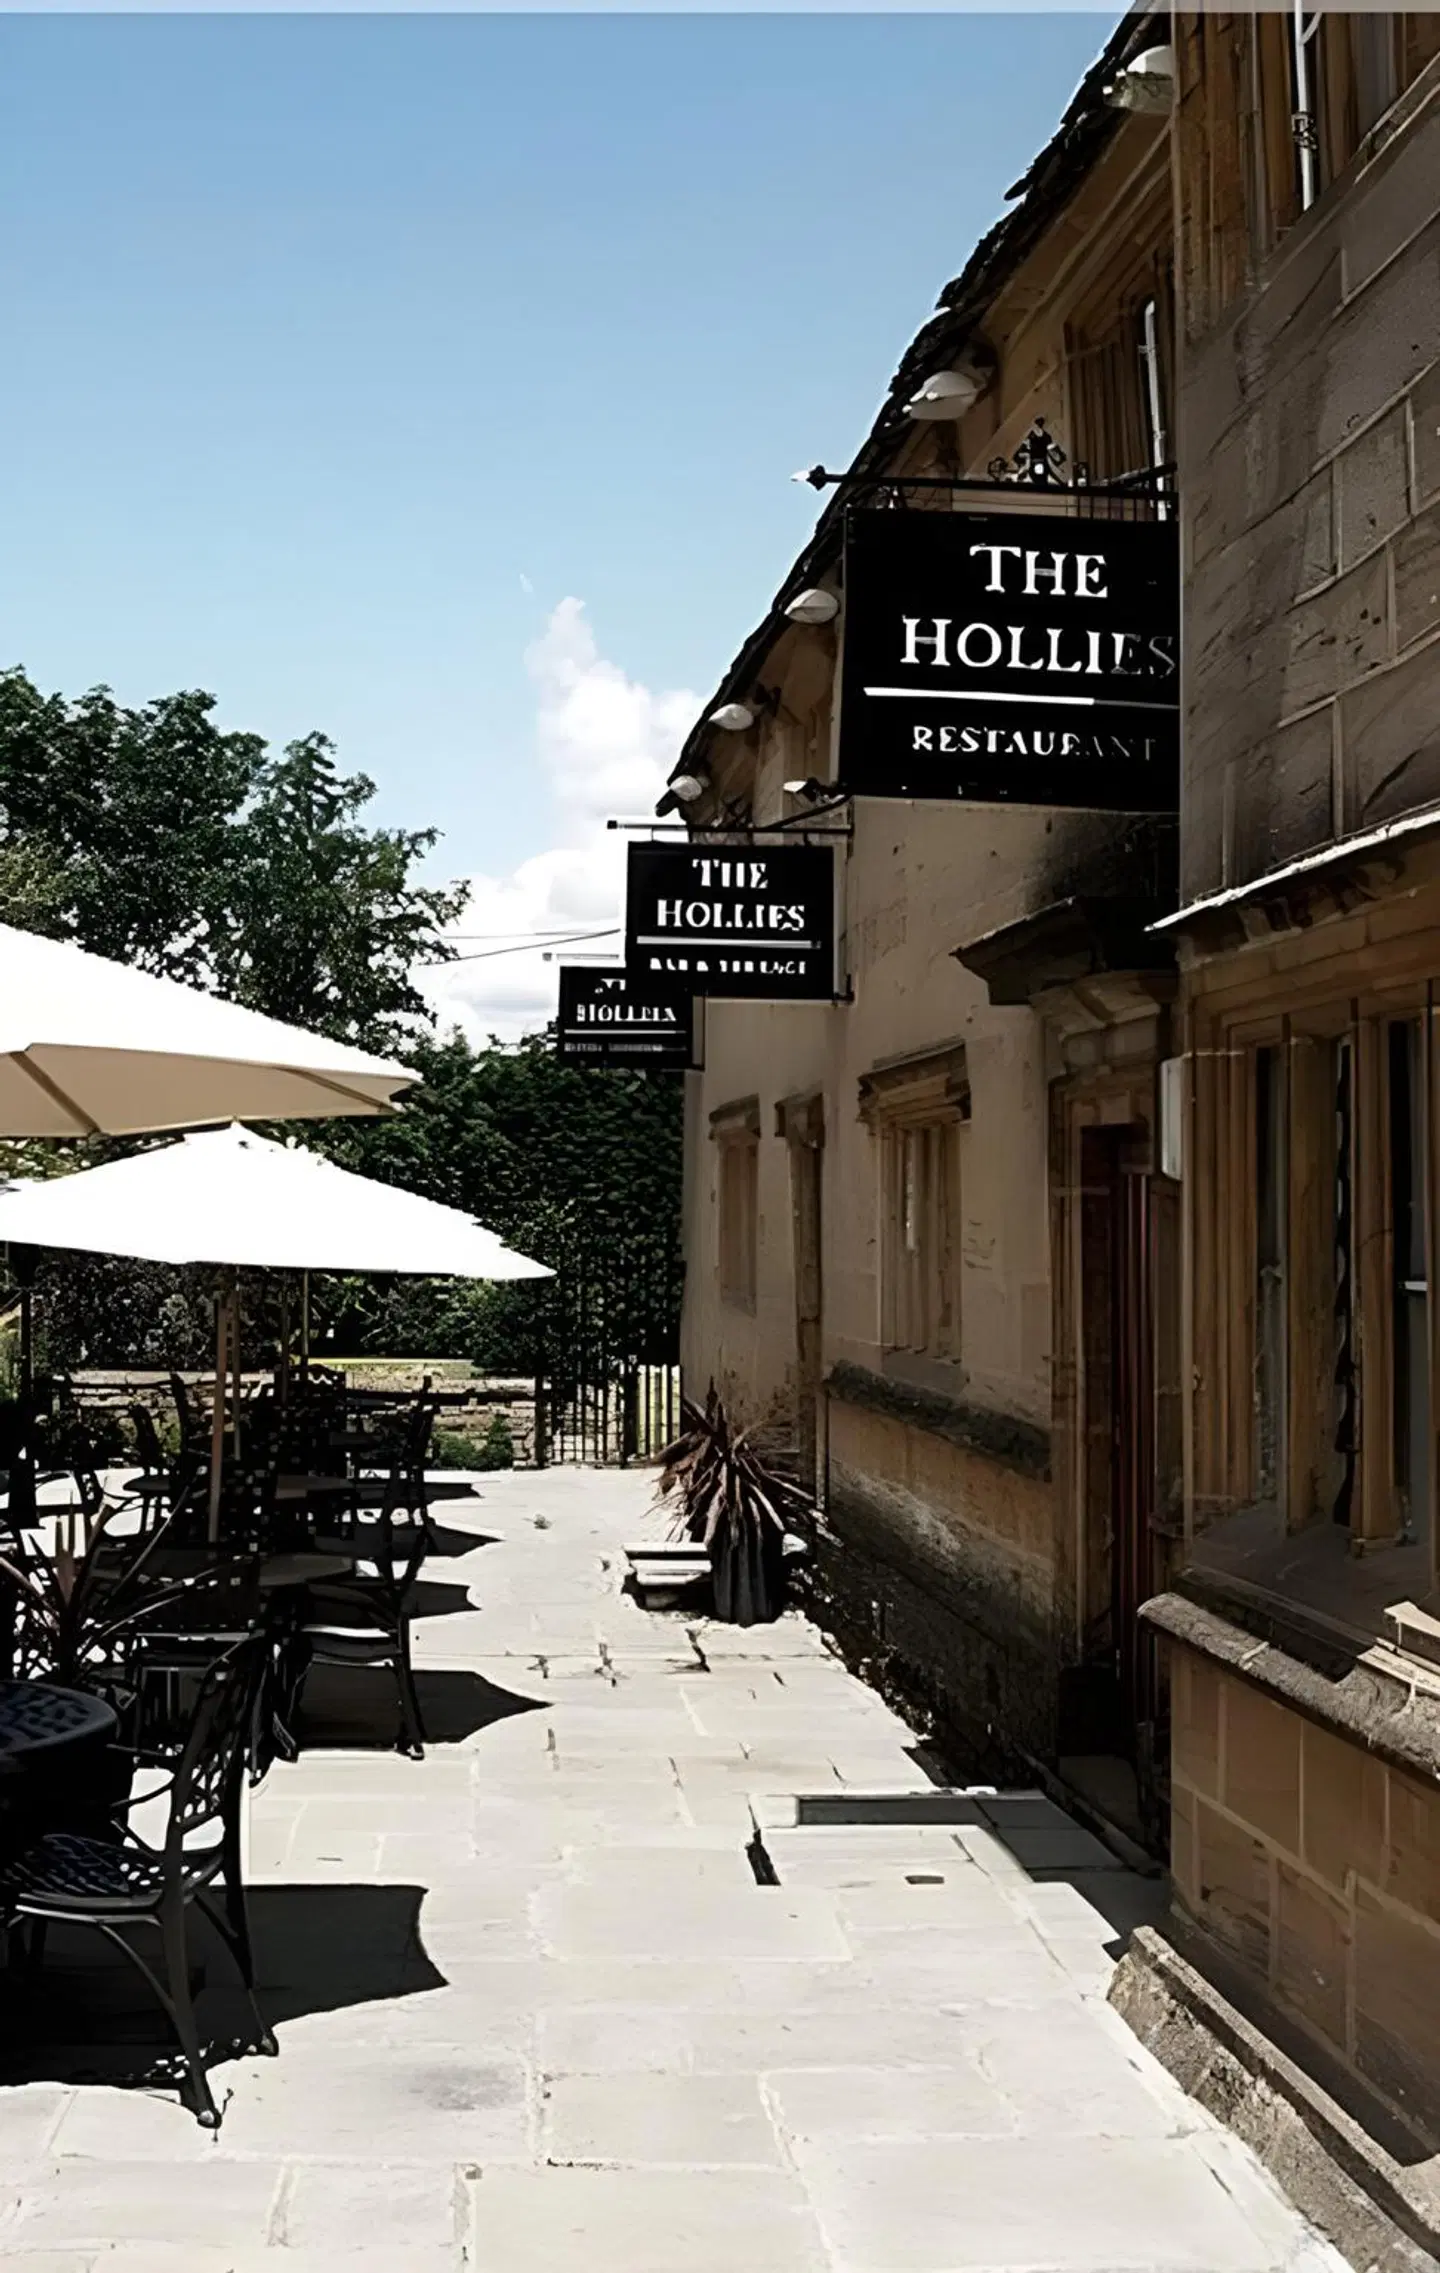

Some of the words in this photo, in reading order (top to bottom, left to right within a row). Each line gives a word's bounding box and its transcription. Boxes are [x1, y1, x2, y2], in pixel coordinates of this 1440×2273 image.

[970, 543, 1108, 598] THE
[900, 615, 1176, 678] HOLLIES
[692, 859, 768, 889] THE
[657, 899, 805, 932] HOLLIES
